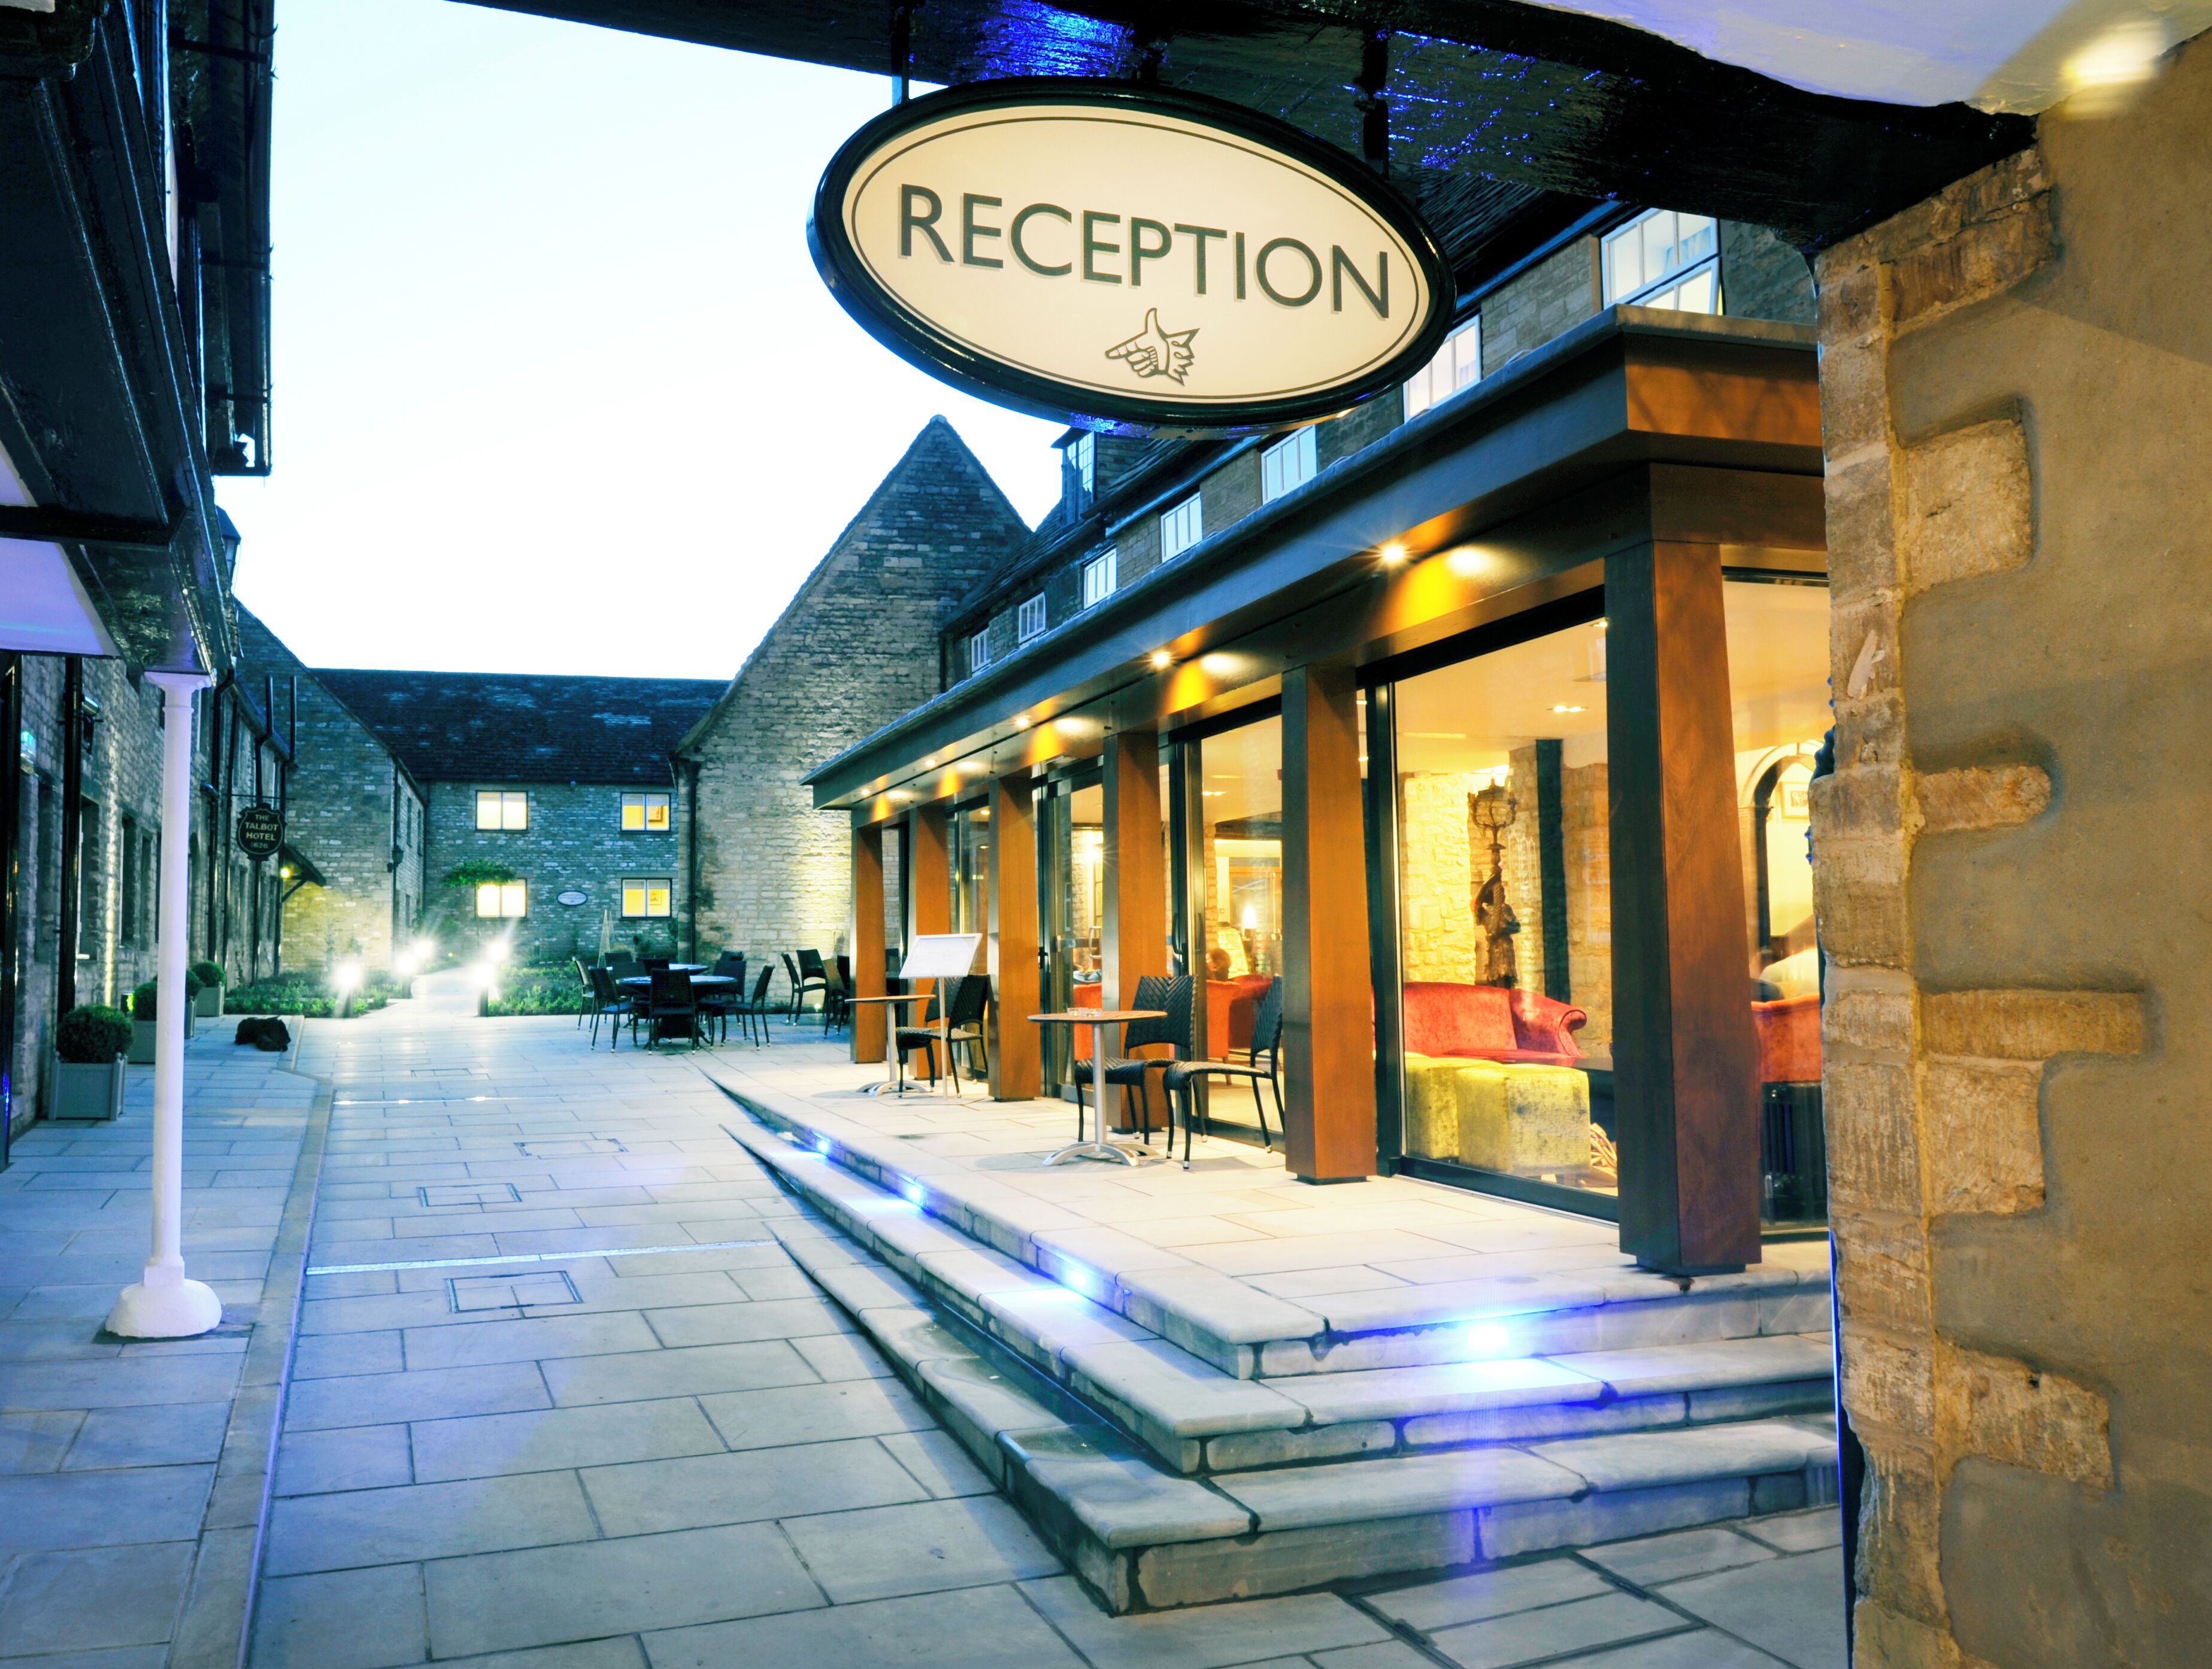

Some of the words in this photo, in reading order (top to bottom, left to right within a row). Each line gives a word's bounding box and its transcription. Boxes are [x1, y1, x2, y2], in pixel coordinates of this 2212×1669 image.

[900, 183, 1390, 320] RECEPTION
[245, 822, 278, 831] TALBOT
[246, 832, 276, 841] HOTEL
